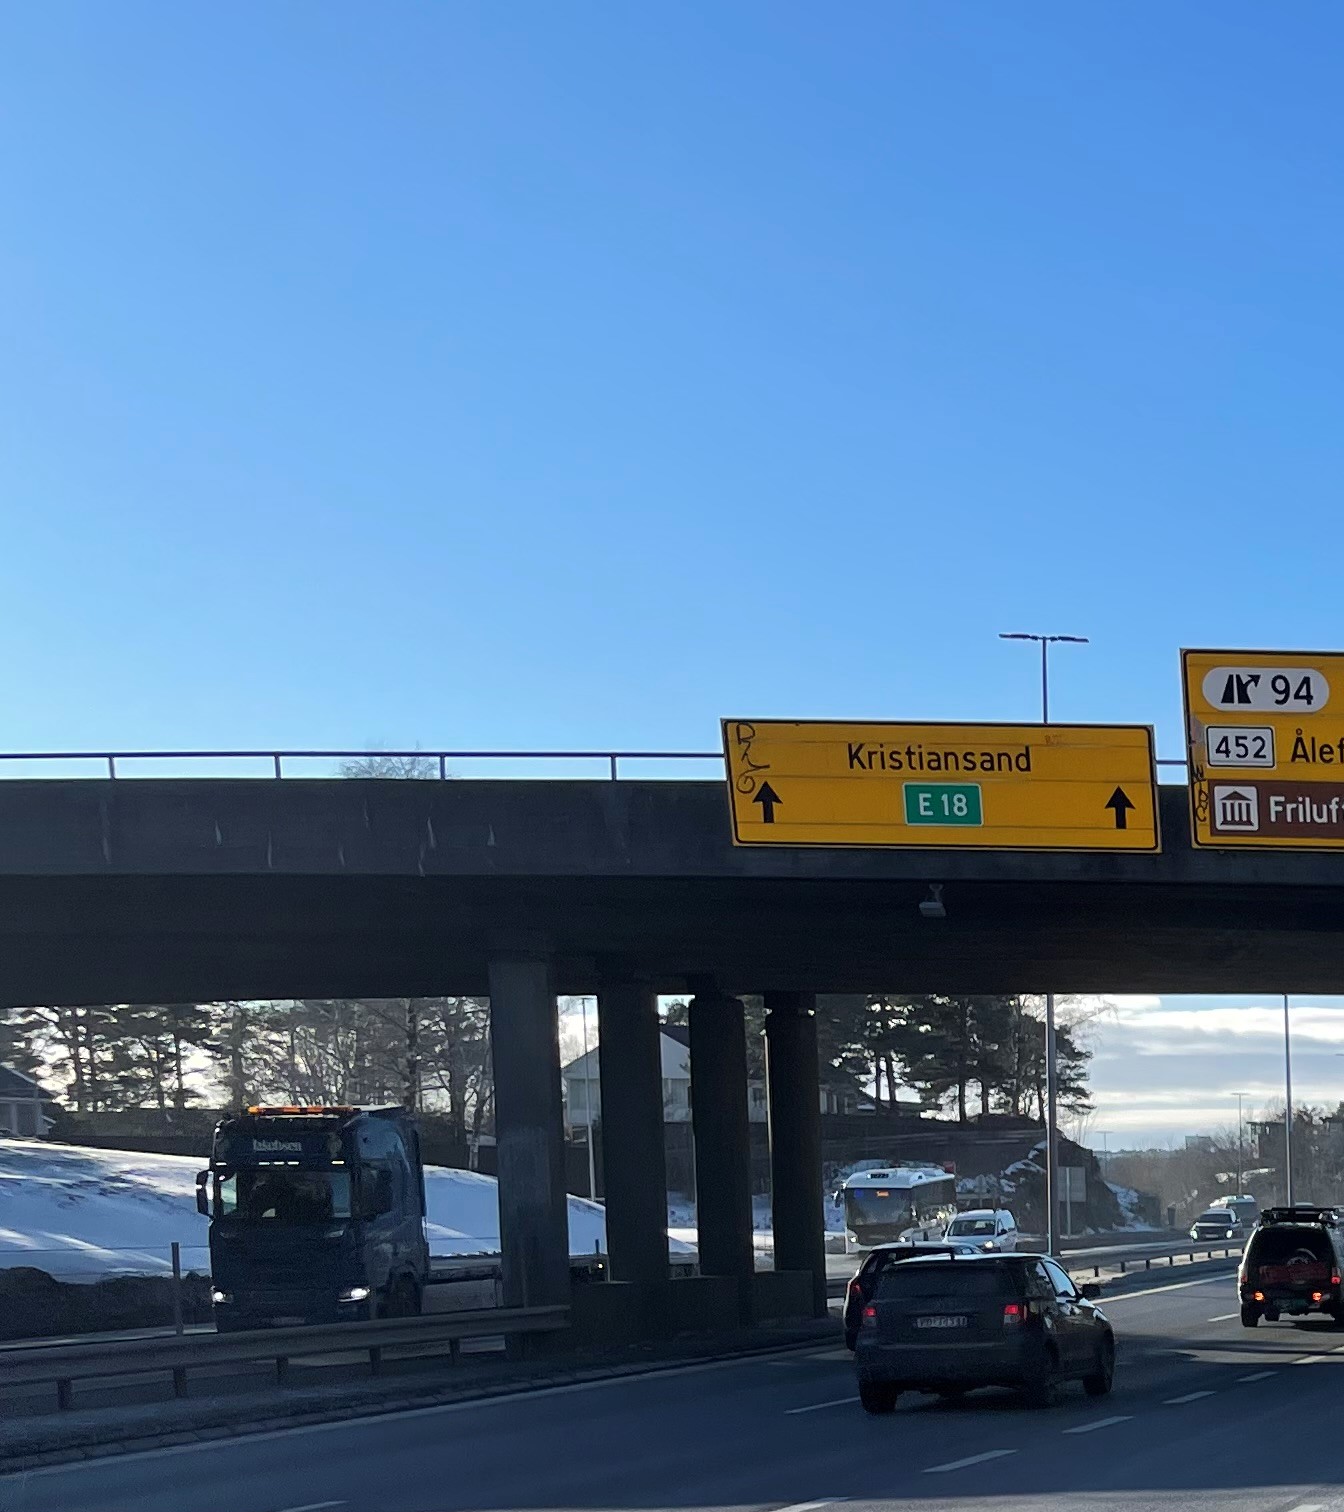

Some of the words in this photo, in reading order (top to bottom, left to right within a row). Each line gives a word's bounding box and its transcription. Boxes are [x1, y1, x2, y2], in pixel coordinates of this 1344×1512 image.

[1270, 673, 1314, 706] 94
[847, 742, 1032, 773] Kristiansand
[1214, 734, 1268, 760] 452
[918, 792, 934, 817] E
[940, 792, 969, 817] 18
